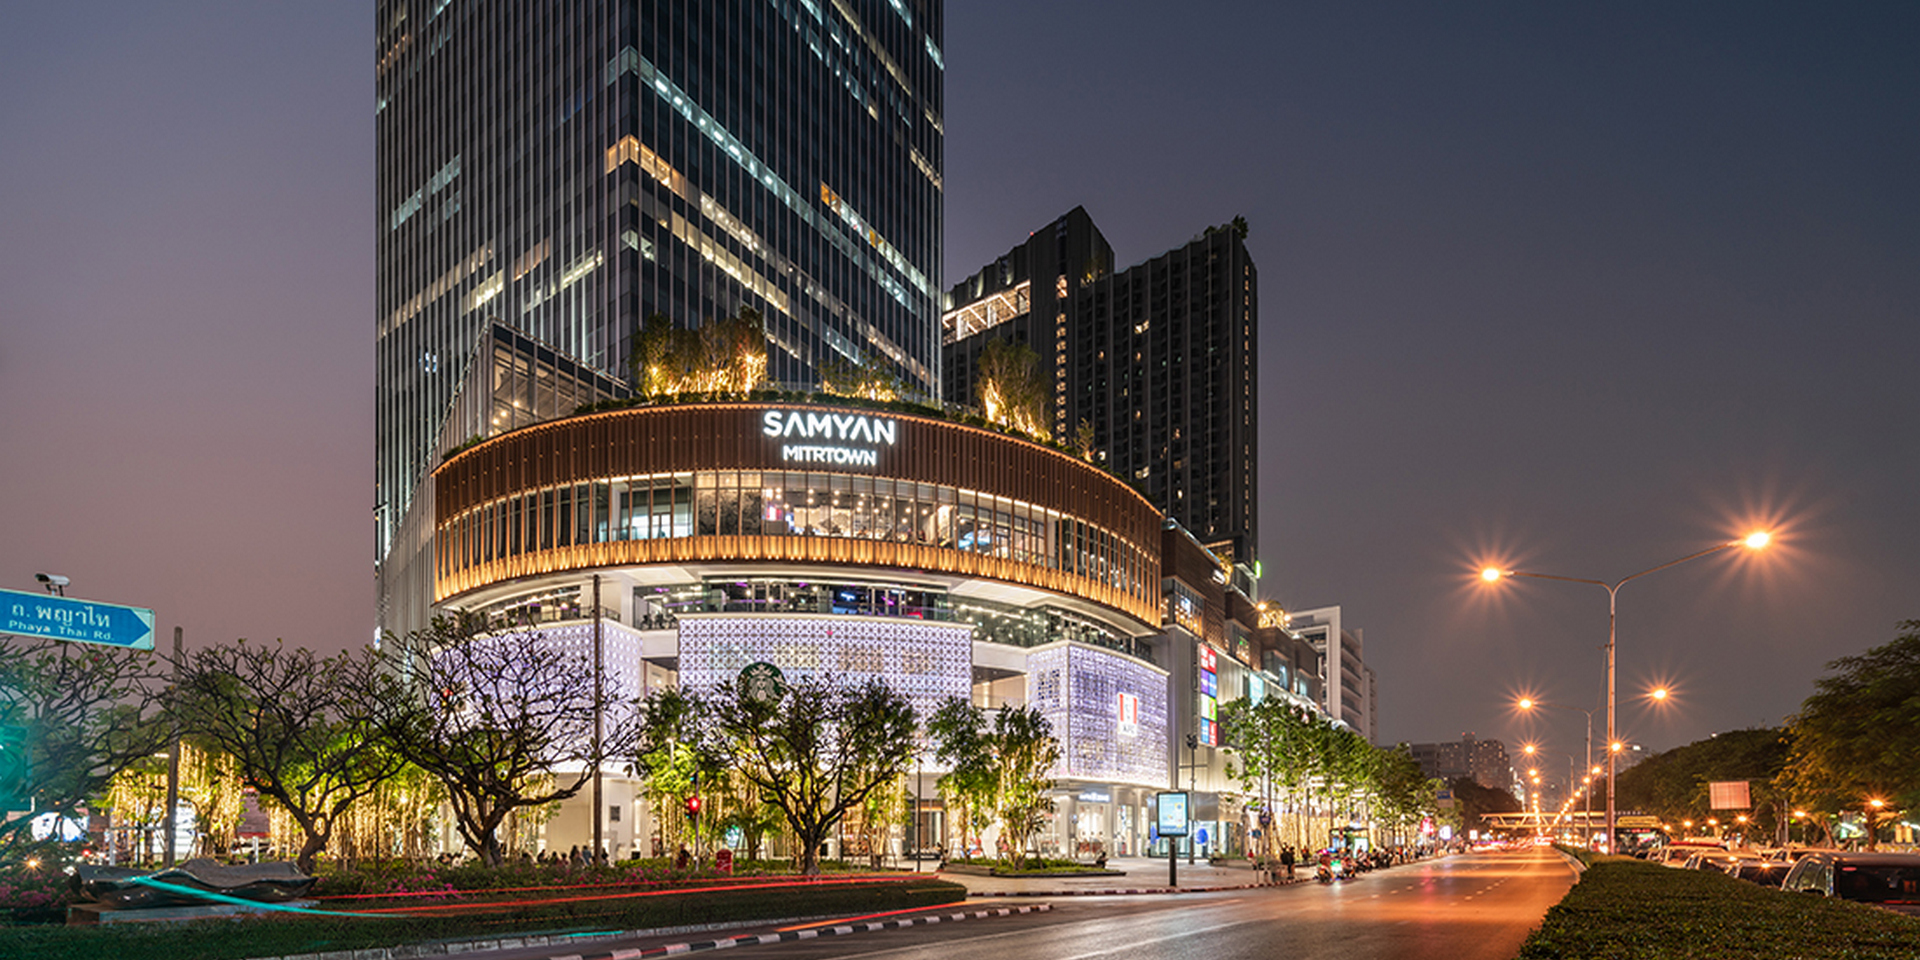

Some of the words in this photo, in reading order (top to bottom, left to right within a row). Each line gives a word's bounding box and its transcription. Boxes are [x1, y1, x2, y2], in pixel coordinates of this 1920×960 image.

[763, 410, 895, 445] SAMYAN
[782, 445, 877, 466] MITRTOWN
[12, 603, 31, 618] ถ.
[35, 604, 111, 628] พญาไท
[8, 620, 51, 635] Phaya
[59, 626, 87, 637] Thai
[93, 631, 115, 641] Rd.
